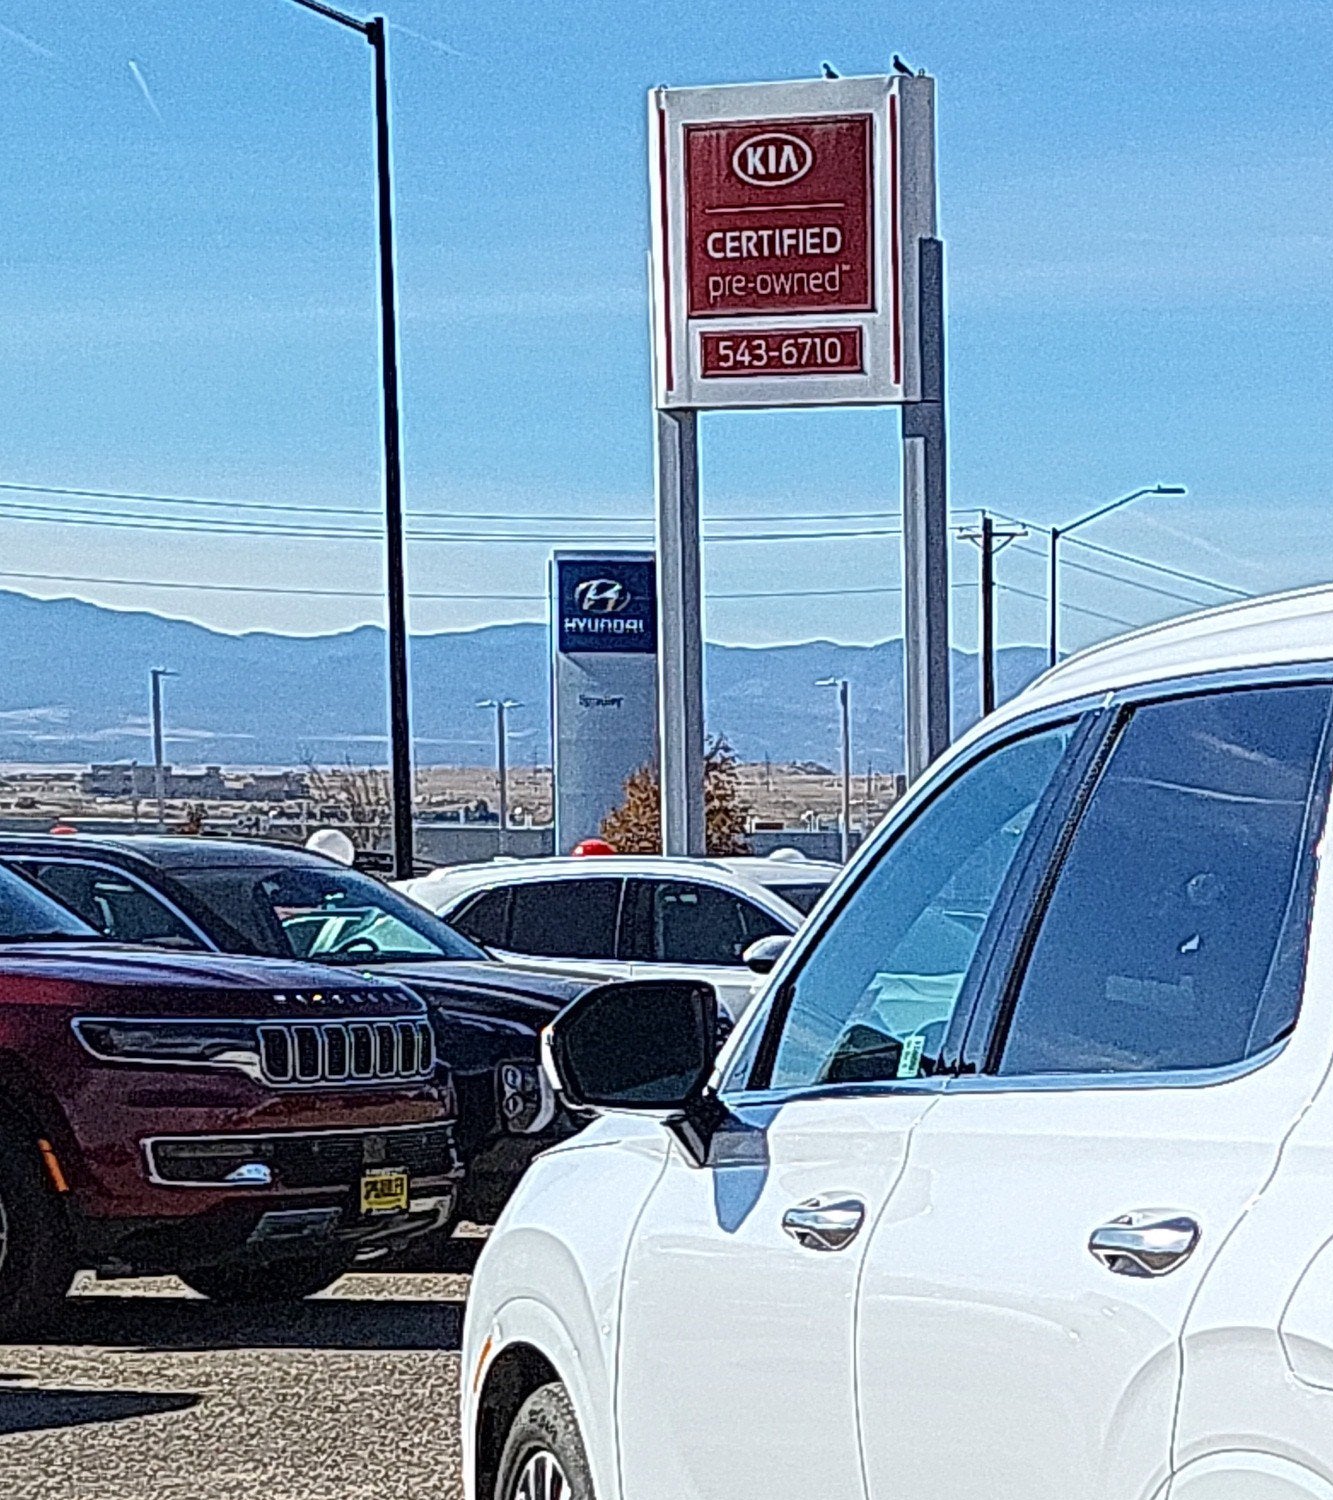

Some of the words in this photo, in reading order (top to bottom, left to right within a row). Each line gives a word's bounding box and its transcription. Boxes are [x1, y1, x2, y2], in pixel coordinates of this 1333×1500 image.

[746, 145, 799, 176] KIA
[706, 226, 842, 259] CERTIFIED
[718, 336, 842, 367] 543-6710
[563, 617, 645, 634] HYUNDAI
